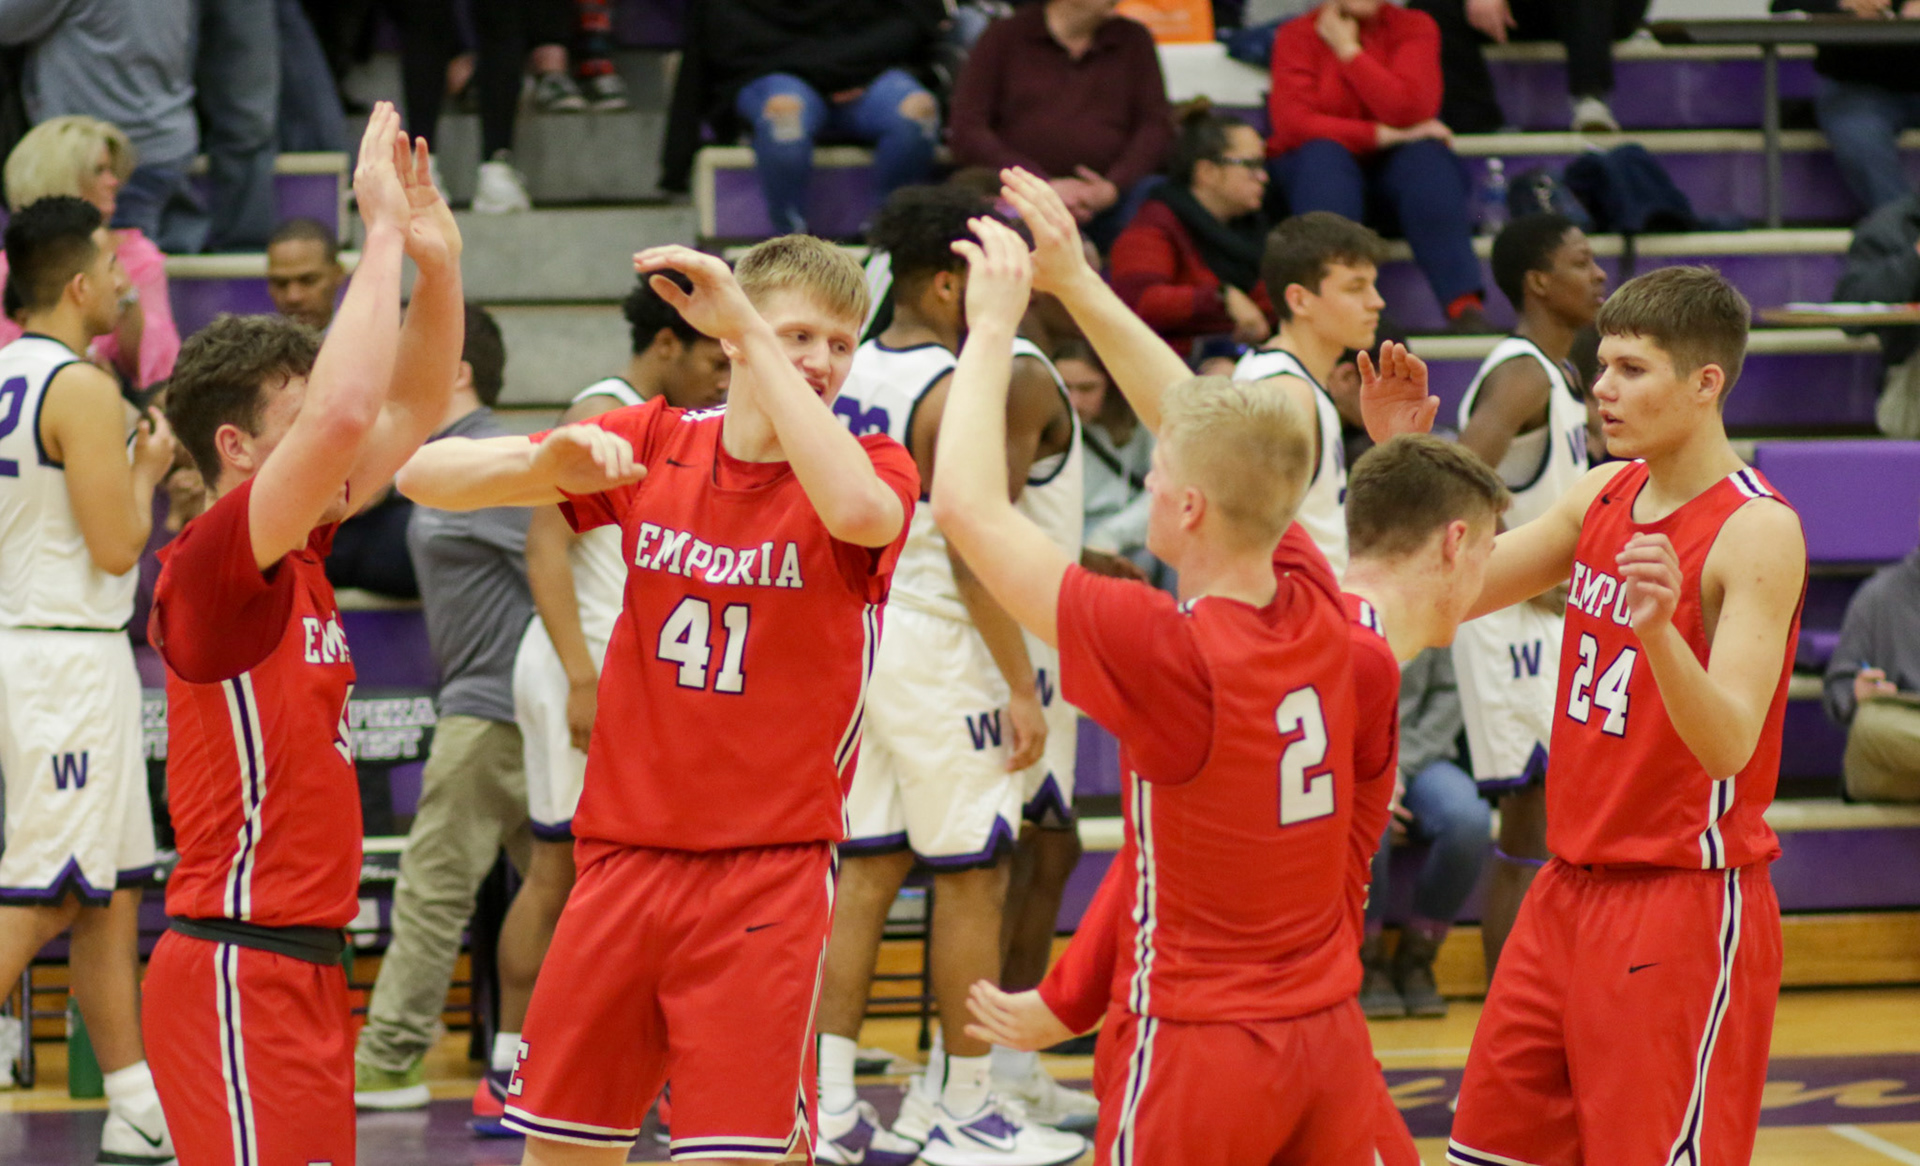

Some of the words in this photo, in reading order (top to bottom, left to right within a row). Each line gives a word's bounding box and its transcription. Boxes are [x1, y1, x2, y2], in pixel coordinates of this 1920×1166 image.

[633, 520, 804, 590] EMPORIA
[1567, 560, 1635, 628] EMPO
[302, 611, 351, 665] EM
[656, 594, 752, 696] 41
[1509, 640, 1541, 678] W
[349, 697, 438, 728] PEKA
[1566, 631, 1638, 739] 24
[965, 709, 1002, 751] W
[1274, 685, 1337, 829] 2
[52, 751, 88, 790] W
